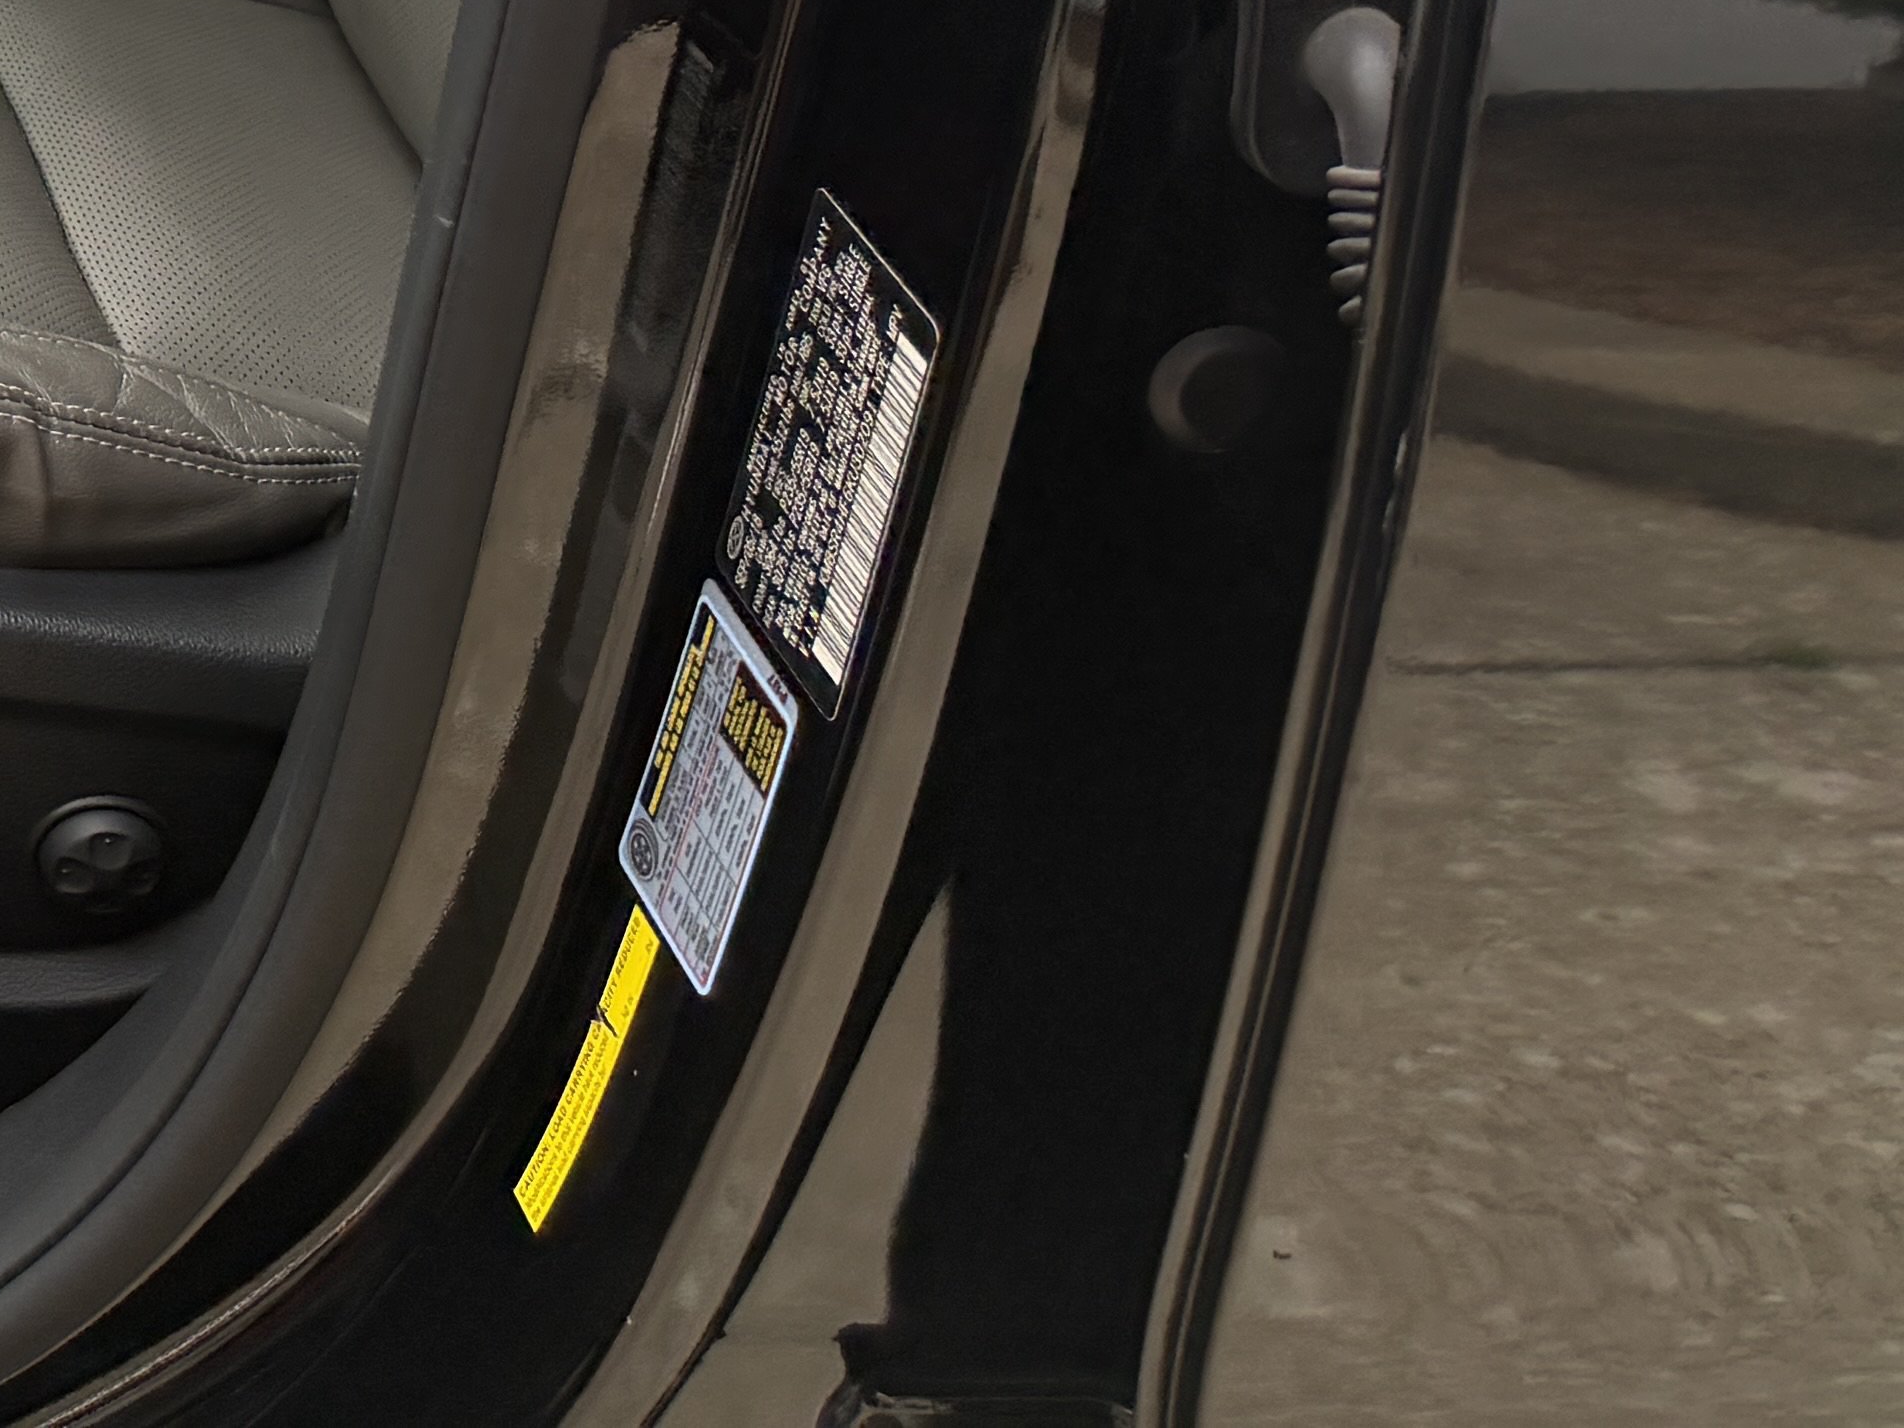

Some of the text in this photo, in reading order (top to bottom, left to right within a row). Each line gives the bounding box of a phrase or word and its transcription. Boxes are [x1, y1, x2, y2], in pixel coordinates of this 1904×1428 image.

[740, 215, 831, 524] HYUNDAI MOTOR COMPANY
[592, 980, 617, 1039] CAACITY
